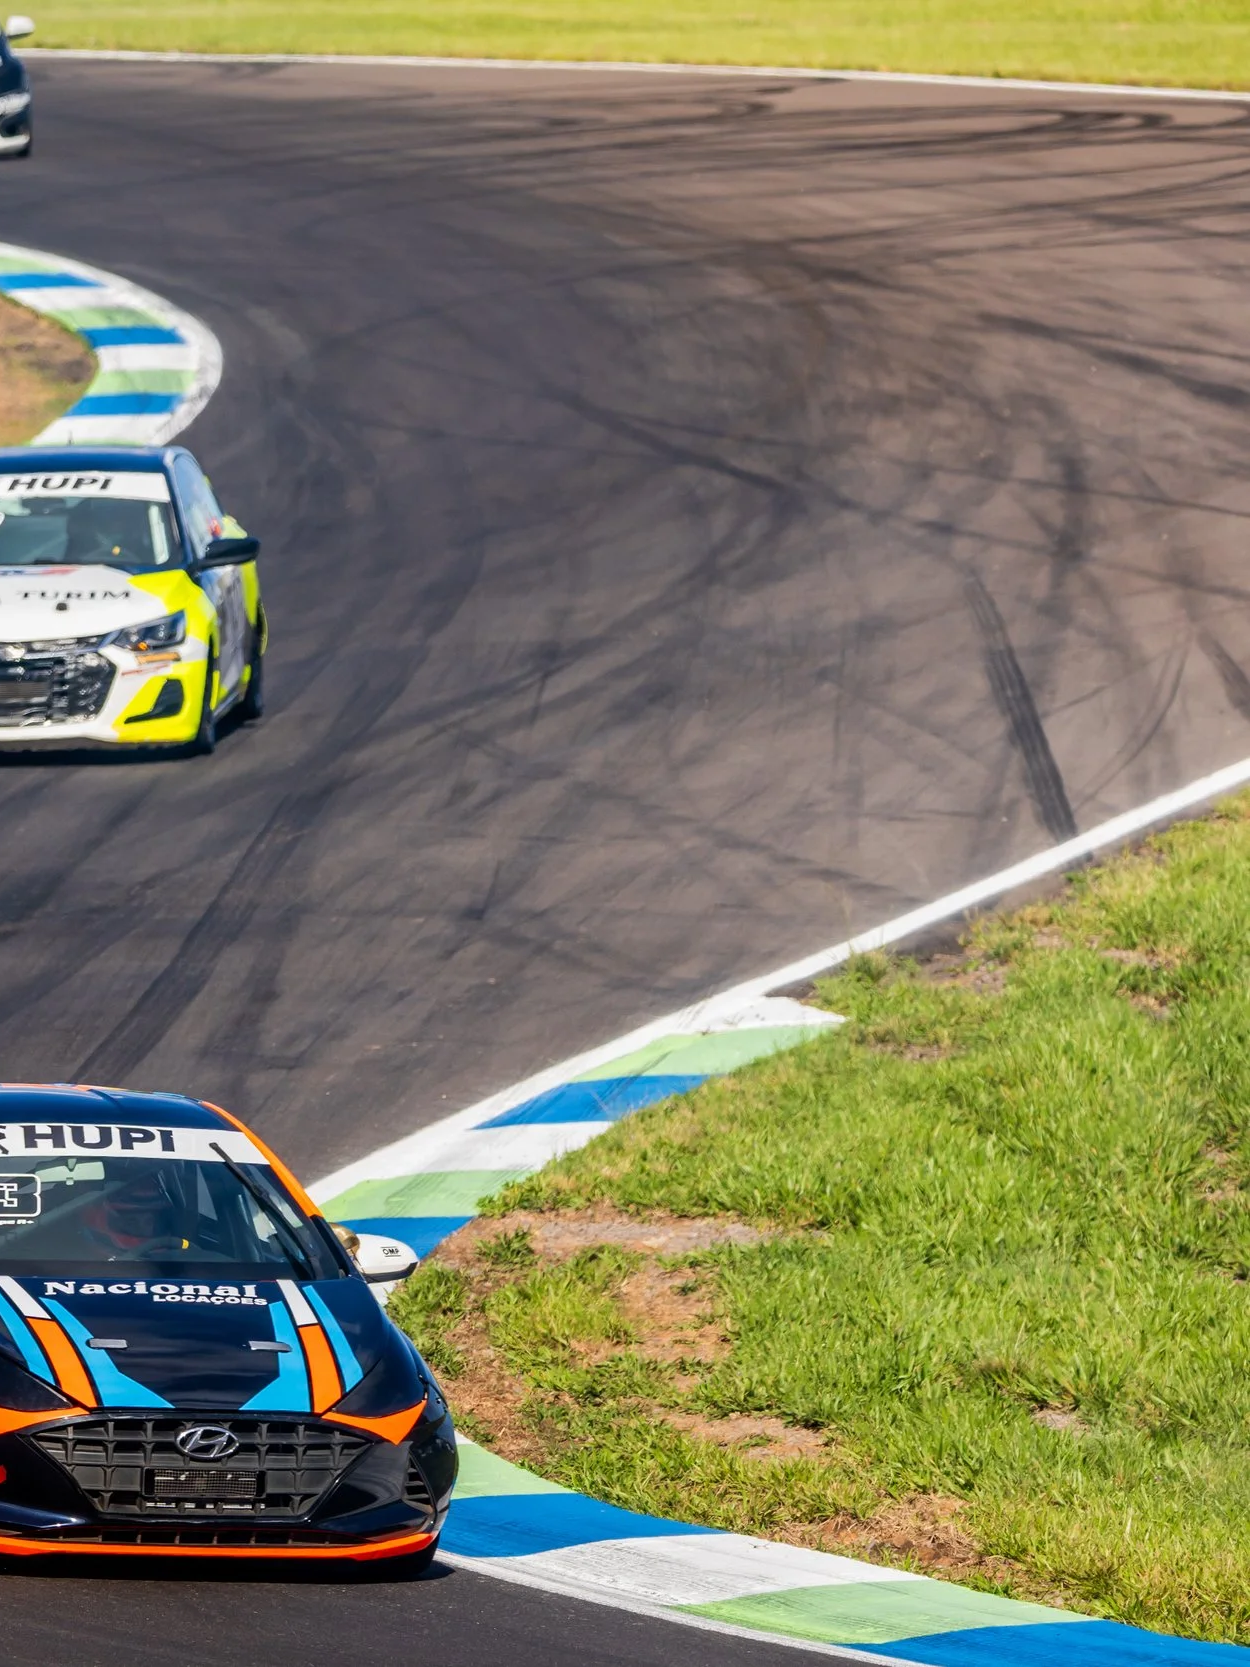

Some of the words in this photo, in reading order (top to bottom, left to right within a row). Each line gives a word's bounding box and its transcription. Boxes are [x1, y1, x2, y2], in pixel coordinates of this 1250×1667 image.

[8, 477, 114, 491] HUPI
[17, 590, 131, 600] TURIM
[20, 1124, 176, 1152] HUPI
[43, 1281, 257, 1298] Nacional
